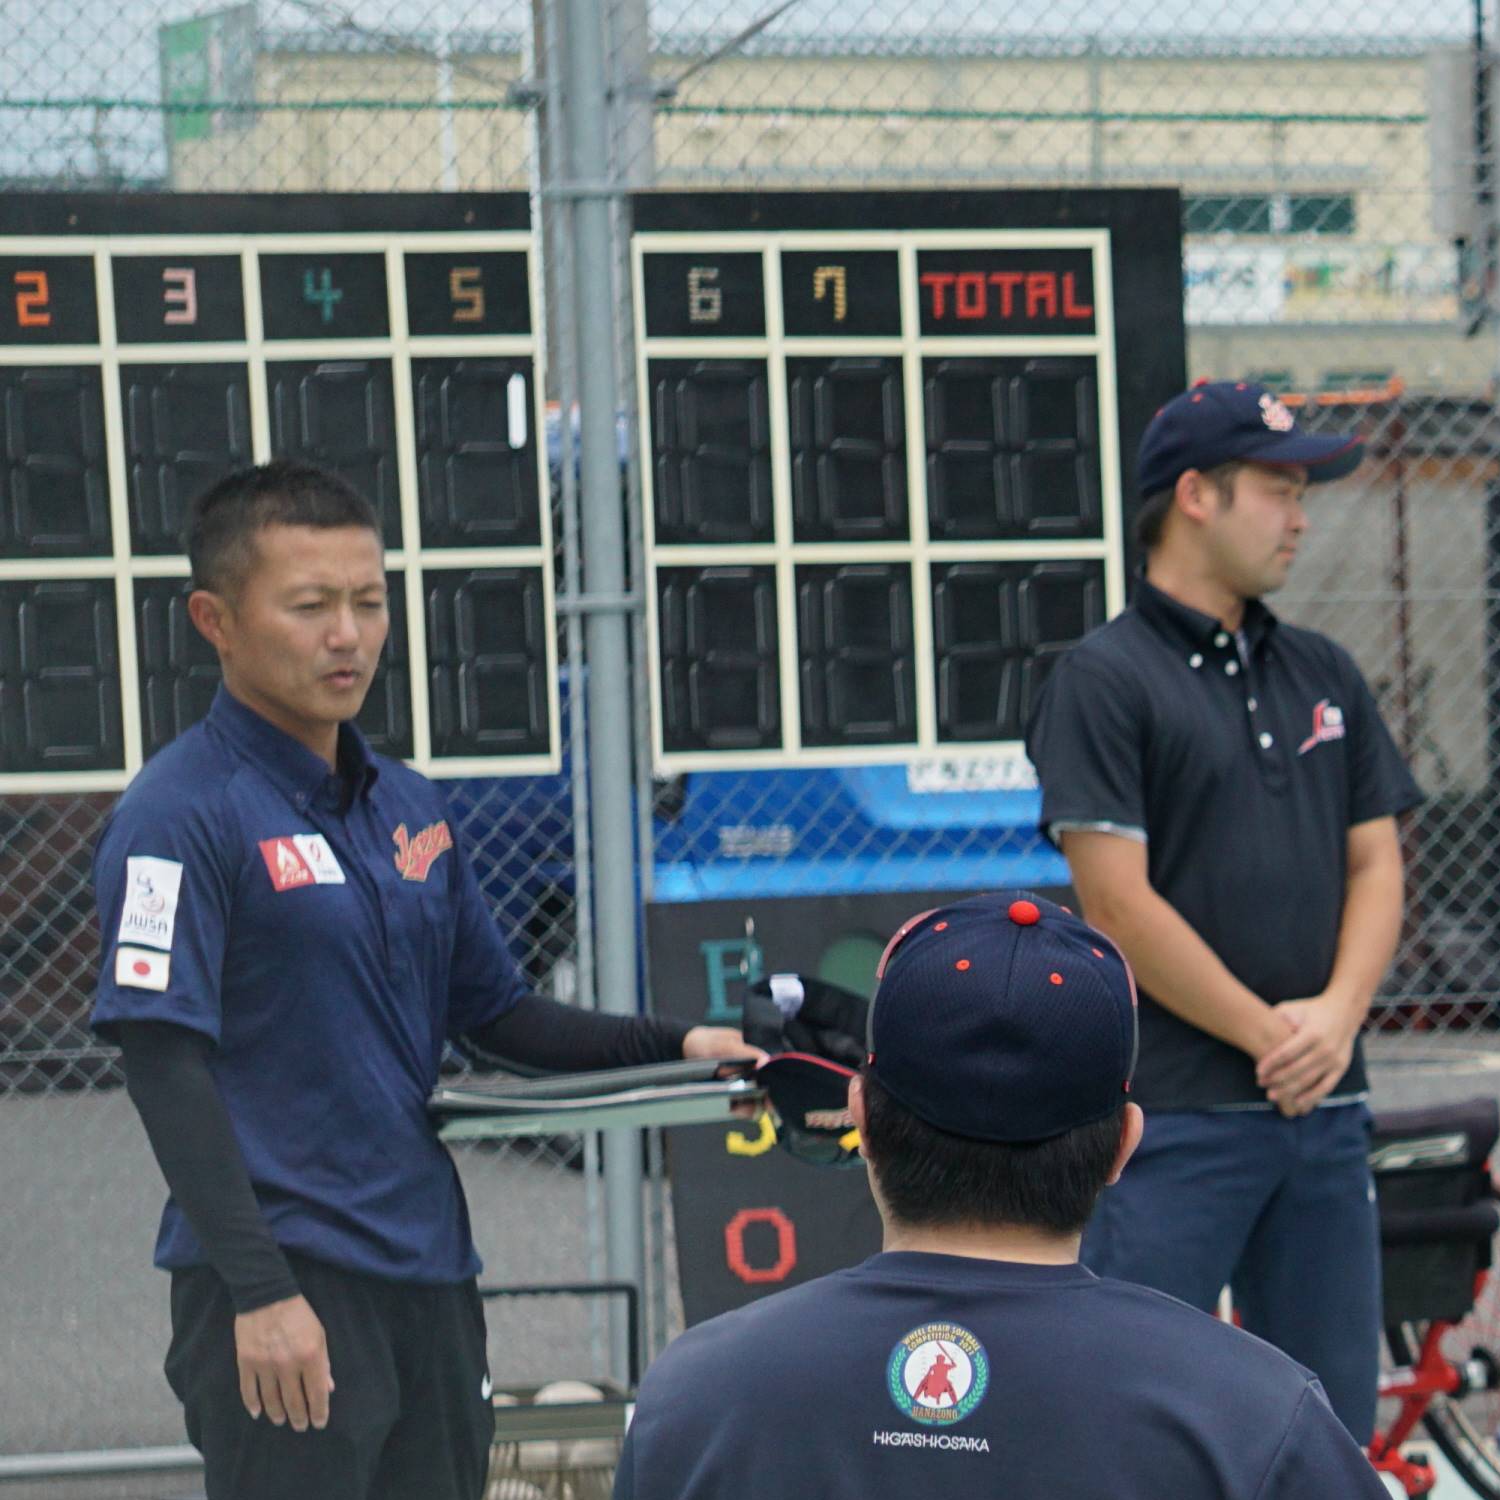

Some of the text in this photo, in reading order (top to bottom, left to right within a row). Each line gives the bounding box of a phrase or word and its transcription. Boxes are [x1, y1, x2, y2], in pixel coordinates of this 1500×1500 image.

[14, 266, 487, 329] 2 3 4 5
[688, 264, 1094, 324] 6 7 TOTAL
[873, 1430, 990, 1453] HIGASHIOSAKA
